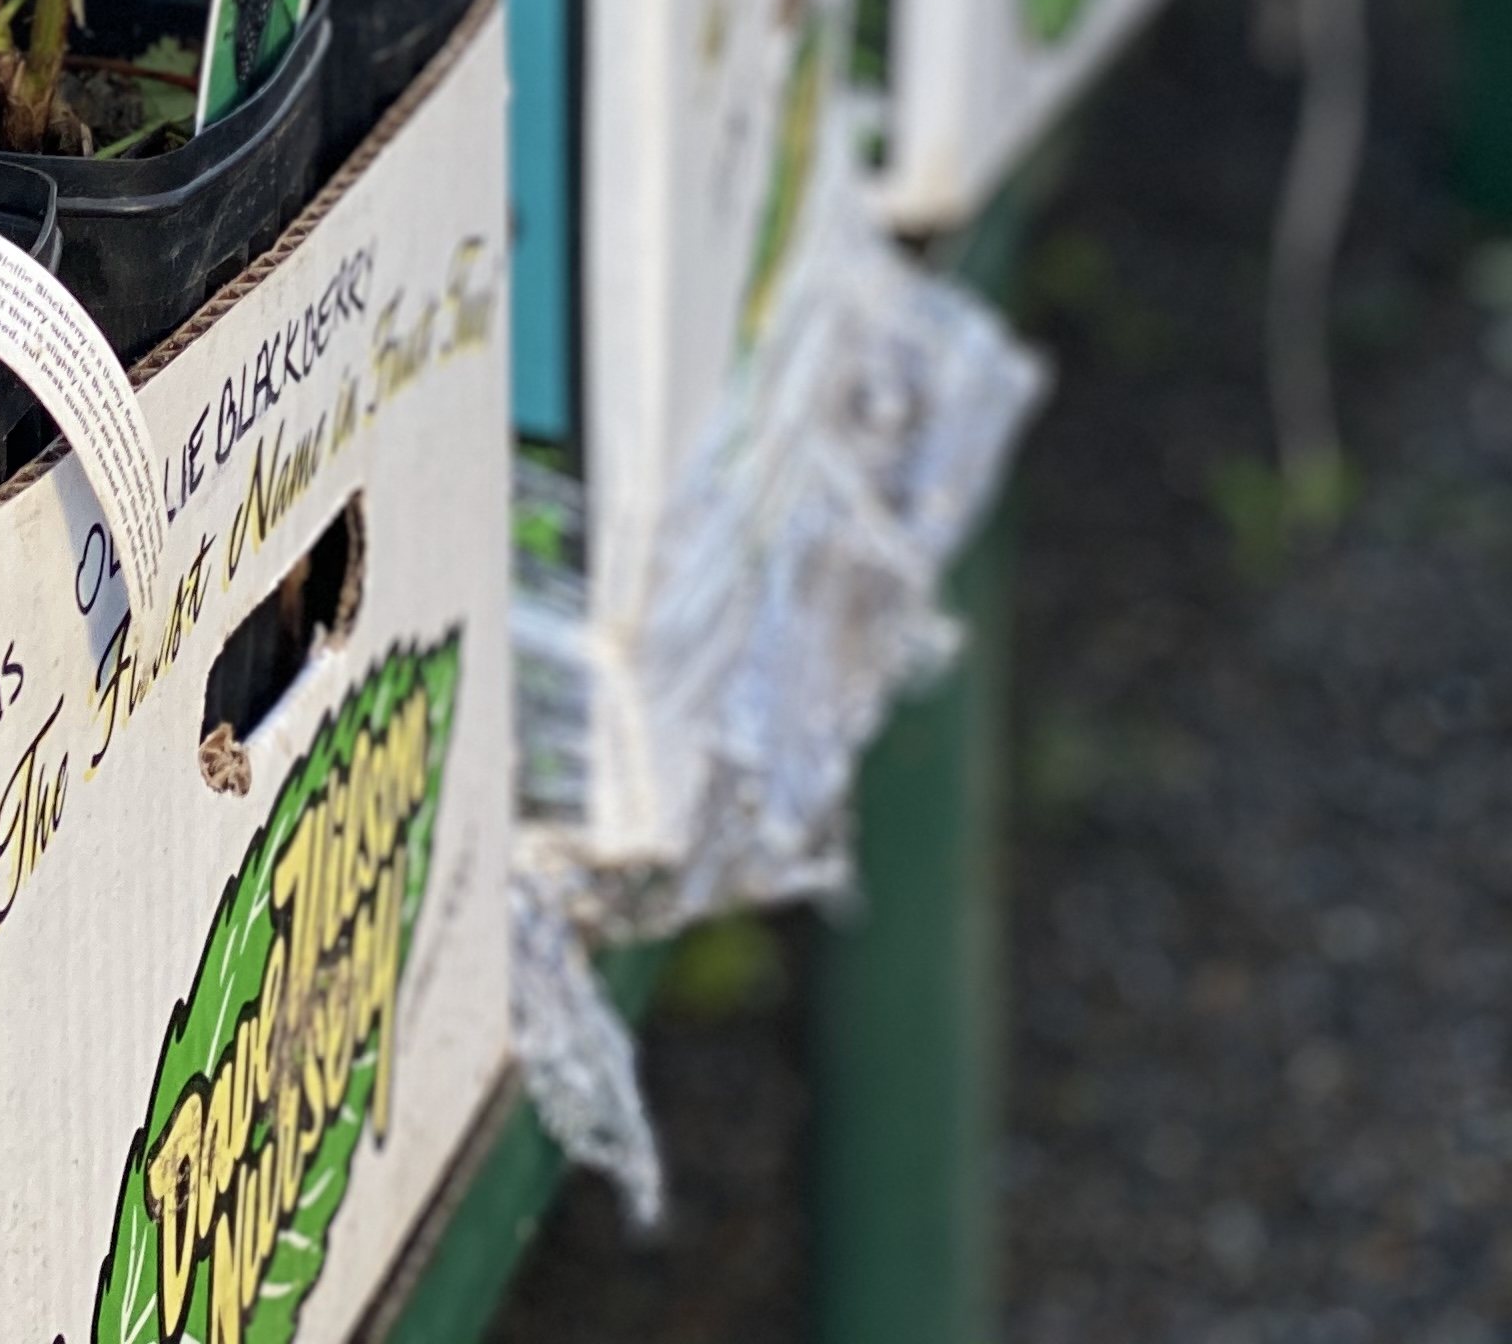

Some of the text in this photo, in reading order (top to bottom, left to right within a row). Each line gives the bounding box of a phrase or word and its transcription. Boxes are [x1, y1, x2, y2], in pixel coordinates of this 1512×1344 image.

[33, 281, 88, 346] Blackberry
[75, 234, 377, 616] OLLIE BLACKBERRY
[228, 412, 327, 583] Name
[146, 688, 428, 1338] Dave Wilson
